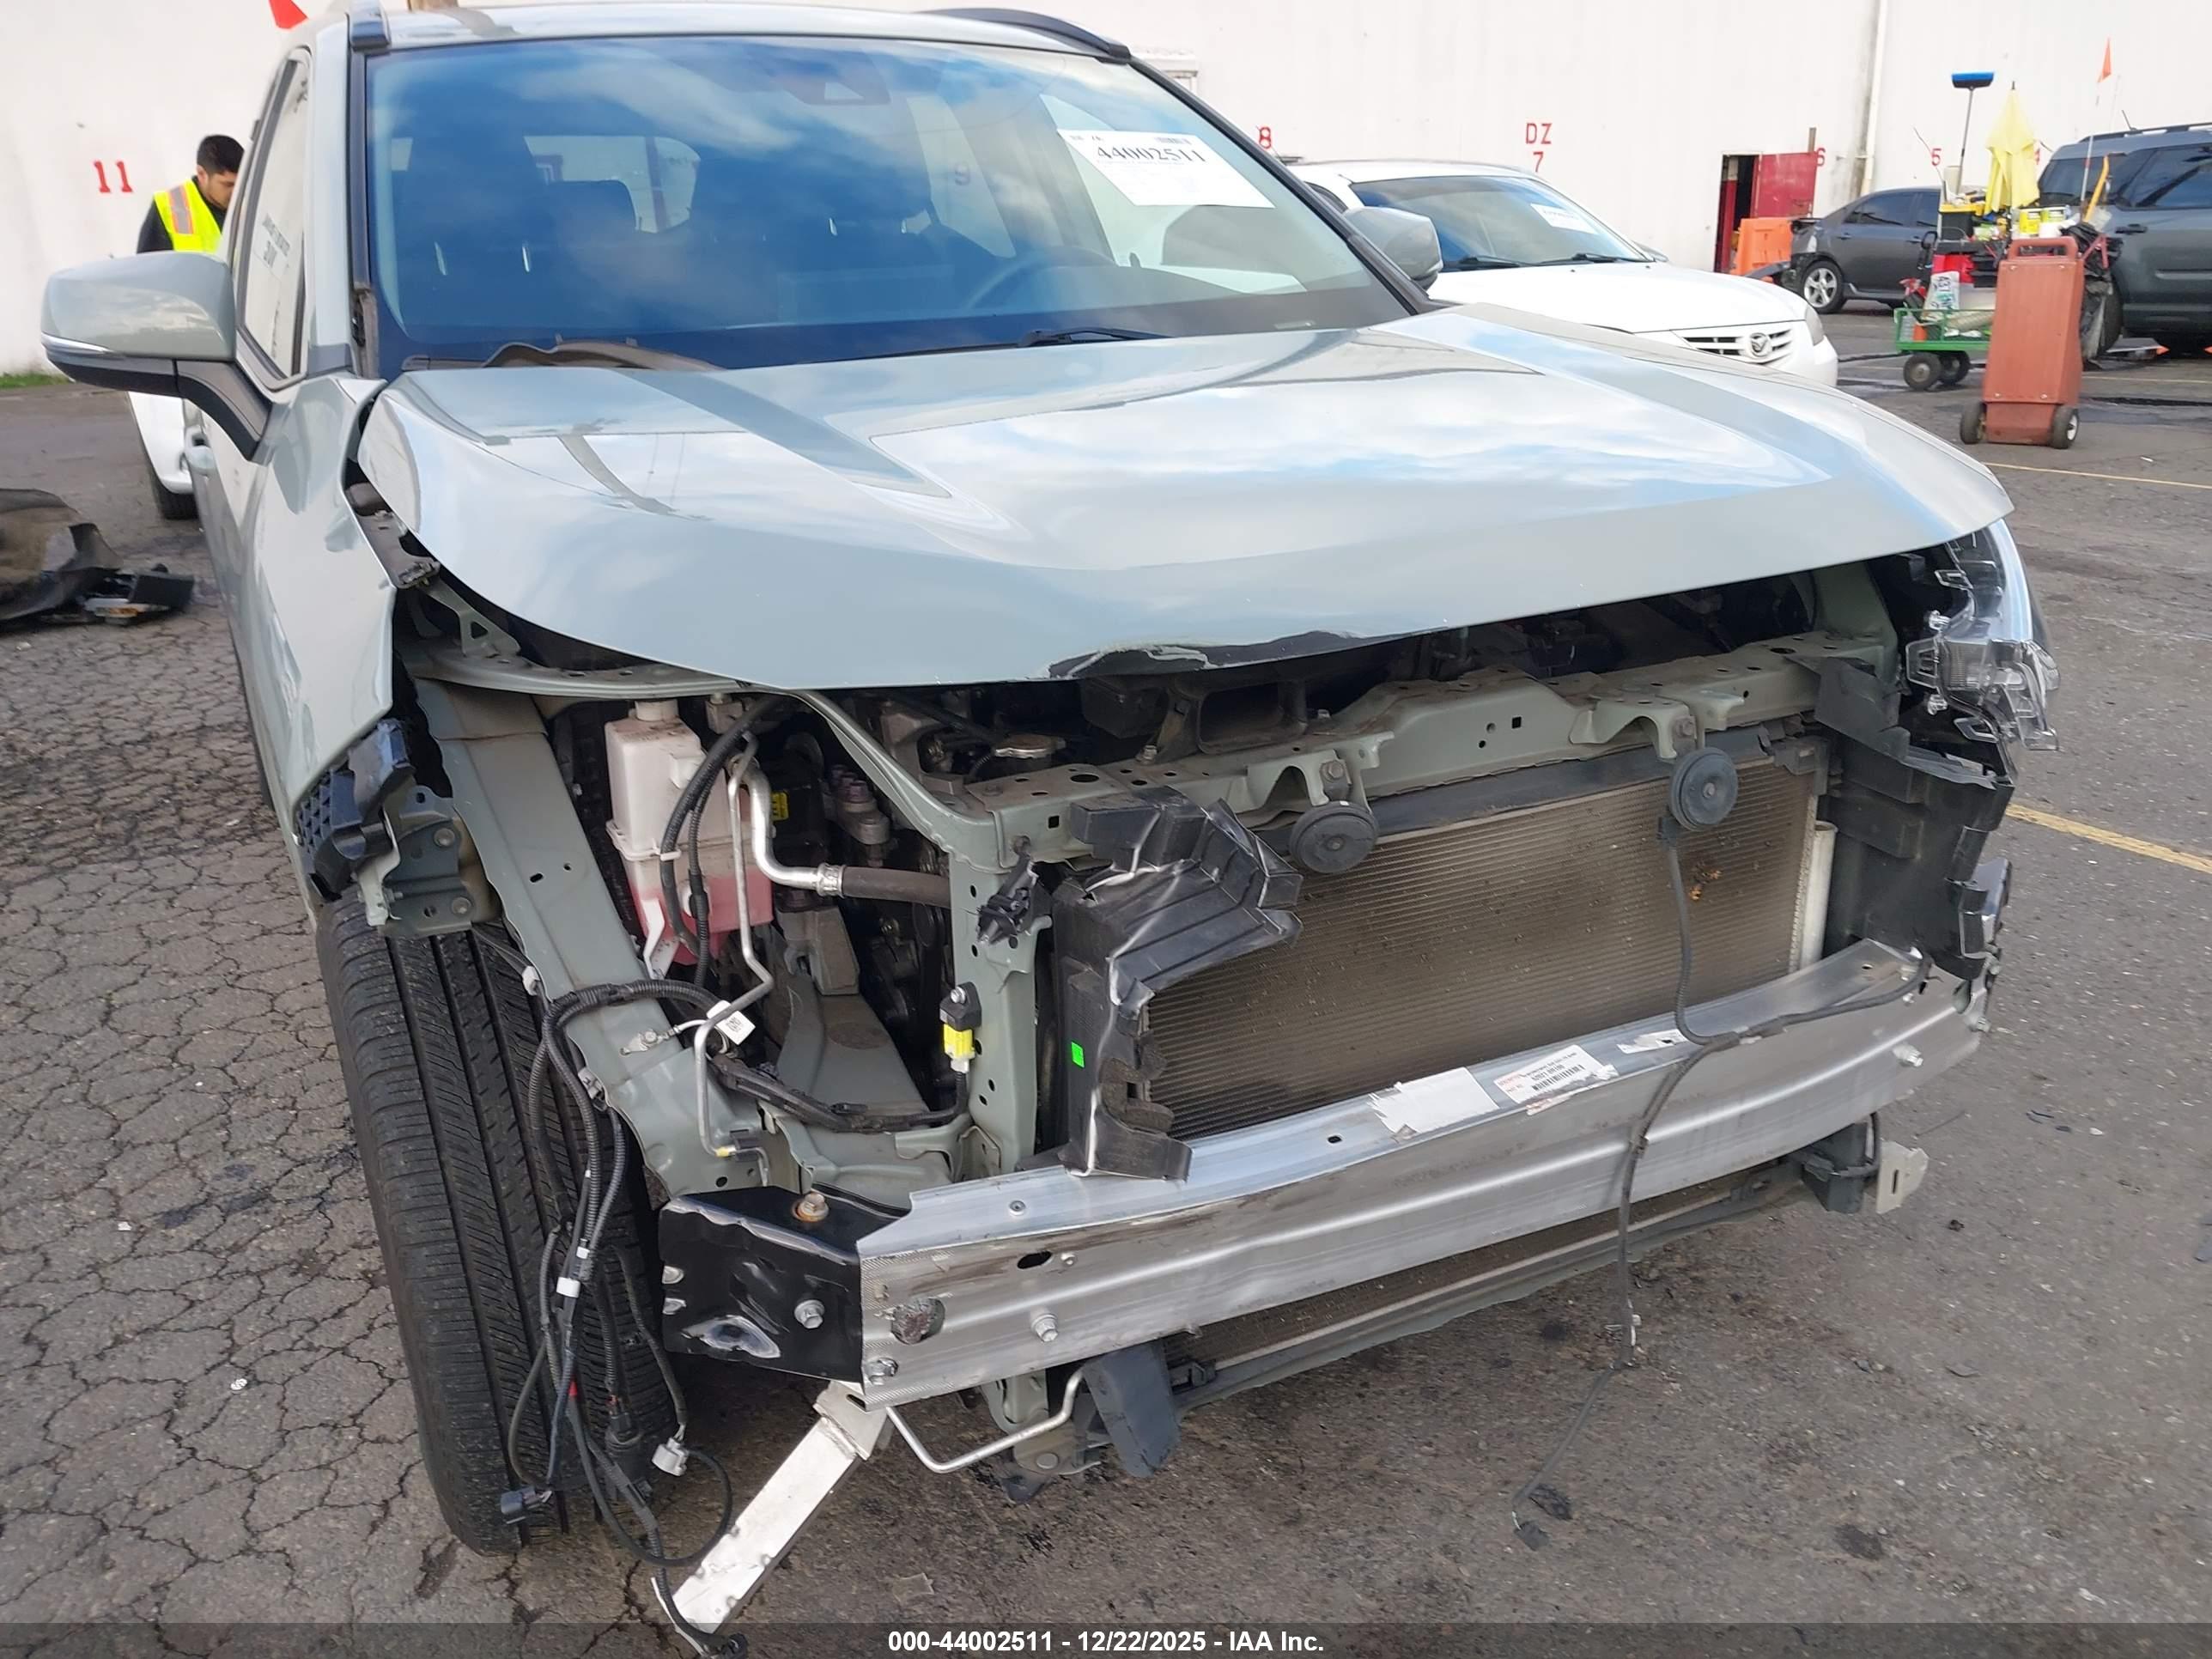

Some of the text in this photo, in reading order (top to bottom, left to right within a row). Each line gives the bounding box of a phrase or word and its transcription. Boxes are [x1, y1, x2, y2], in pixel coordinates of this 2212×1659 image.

[1258, 126, 1272, 149] 8
[1525, 122, 1552, 144] DZ
[1097, 142, 1206, 162] 44002511
[1532, 150, 1544, 173] 7
[1815, 147, 1826, 167] 6
[1931, 148, 1942, 167] 5
[94, 161, 134, 193] 11
